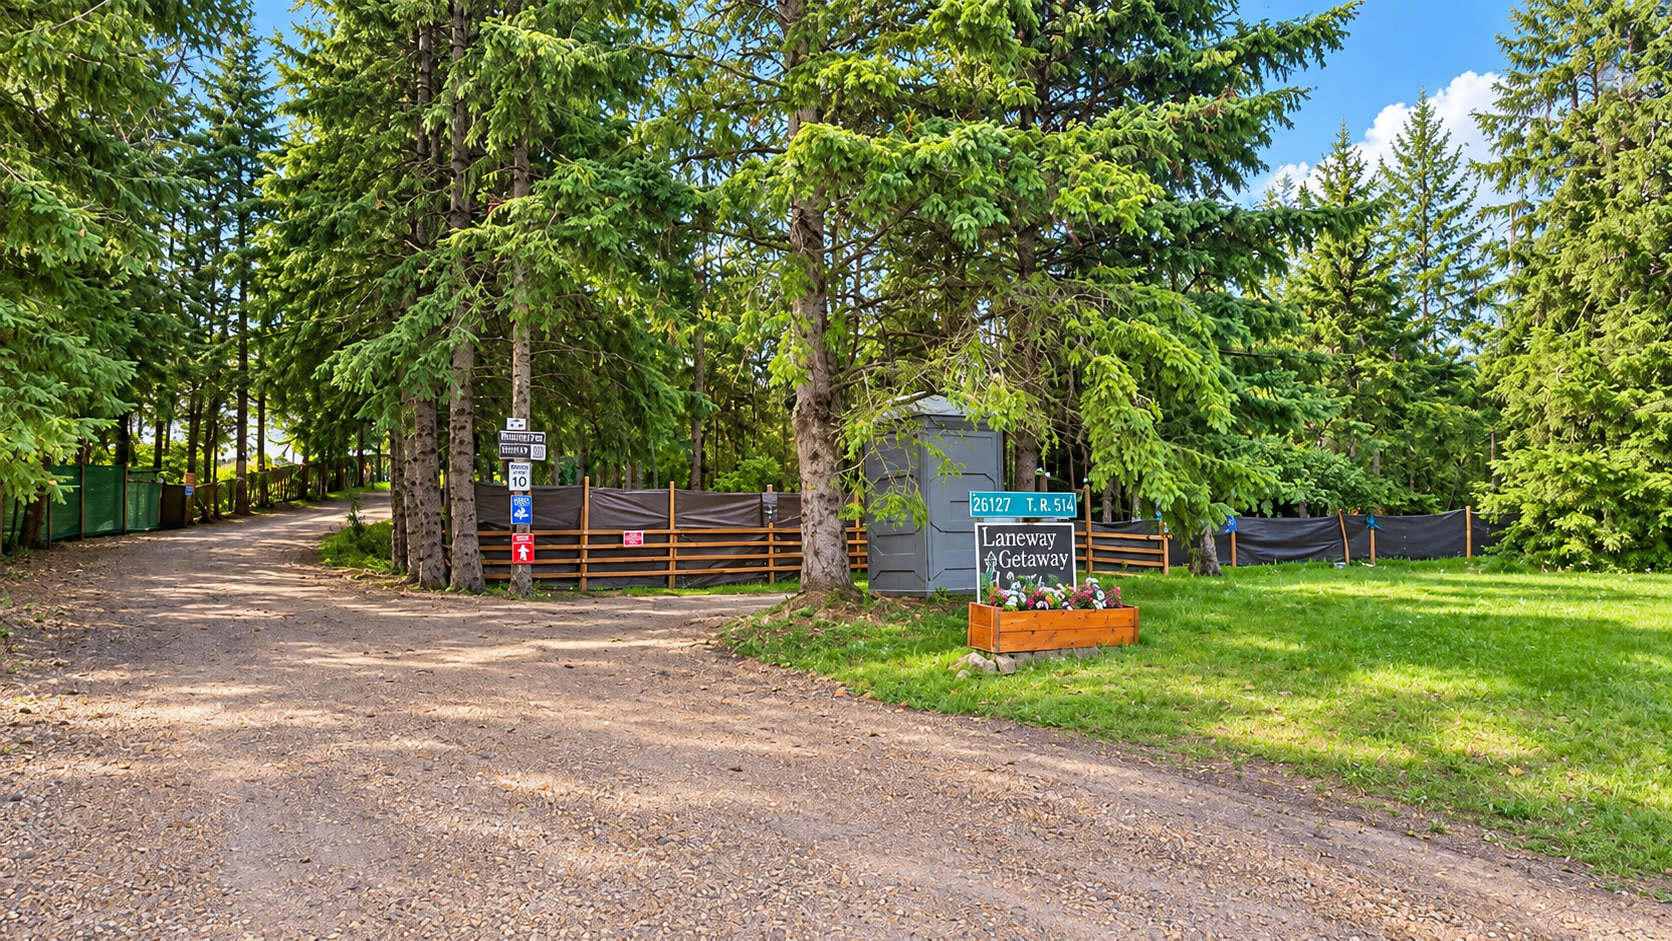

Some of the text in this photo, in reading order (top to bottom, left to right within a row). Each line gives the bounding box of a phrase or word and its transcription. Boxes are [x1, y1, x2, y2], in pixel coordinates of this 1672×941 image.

[512, 476, 527, 487] 10
[973, 497, 1011, 512] 26127
[1054, 495, 1074, 512] 514
[982, 526, 1057, 550] Laneway
[999, 549, 1069, 570] Getaway
